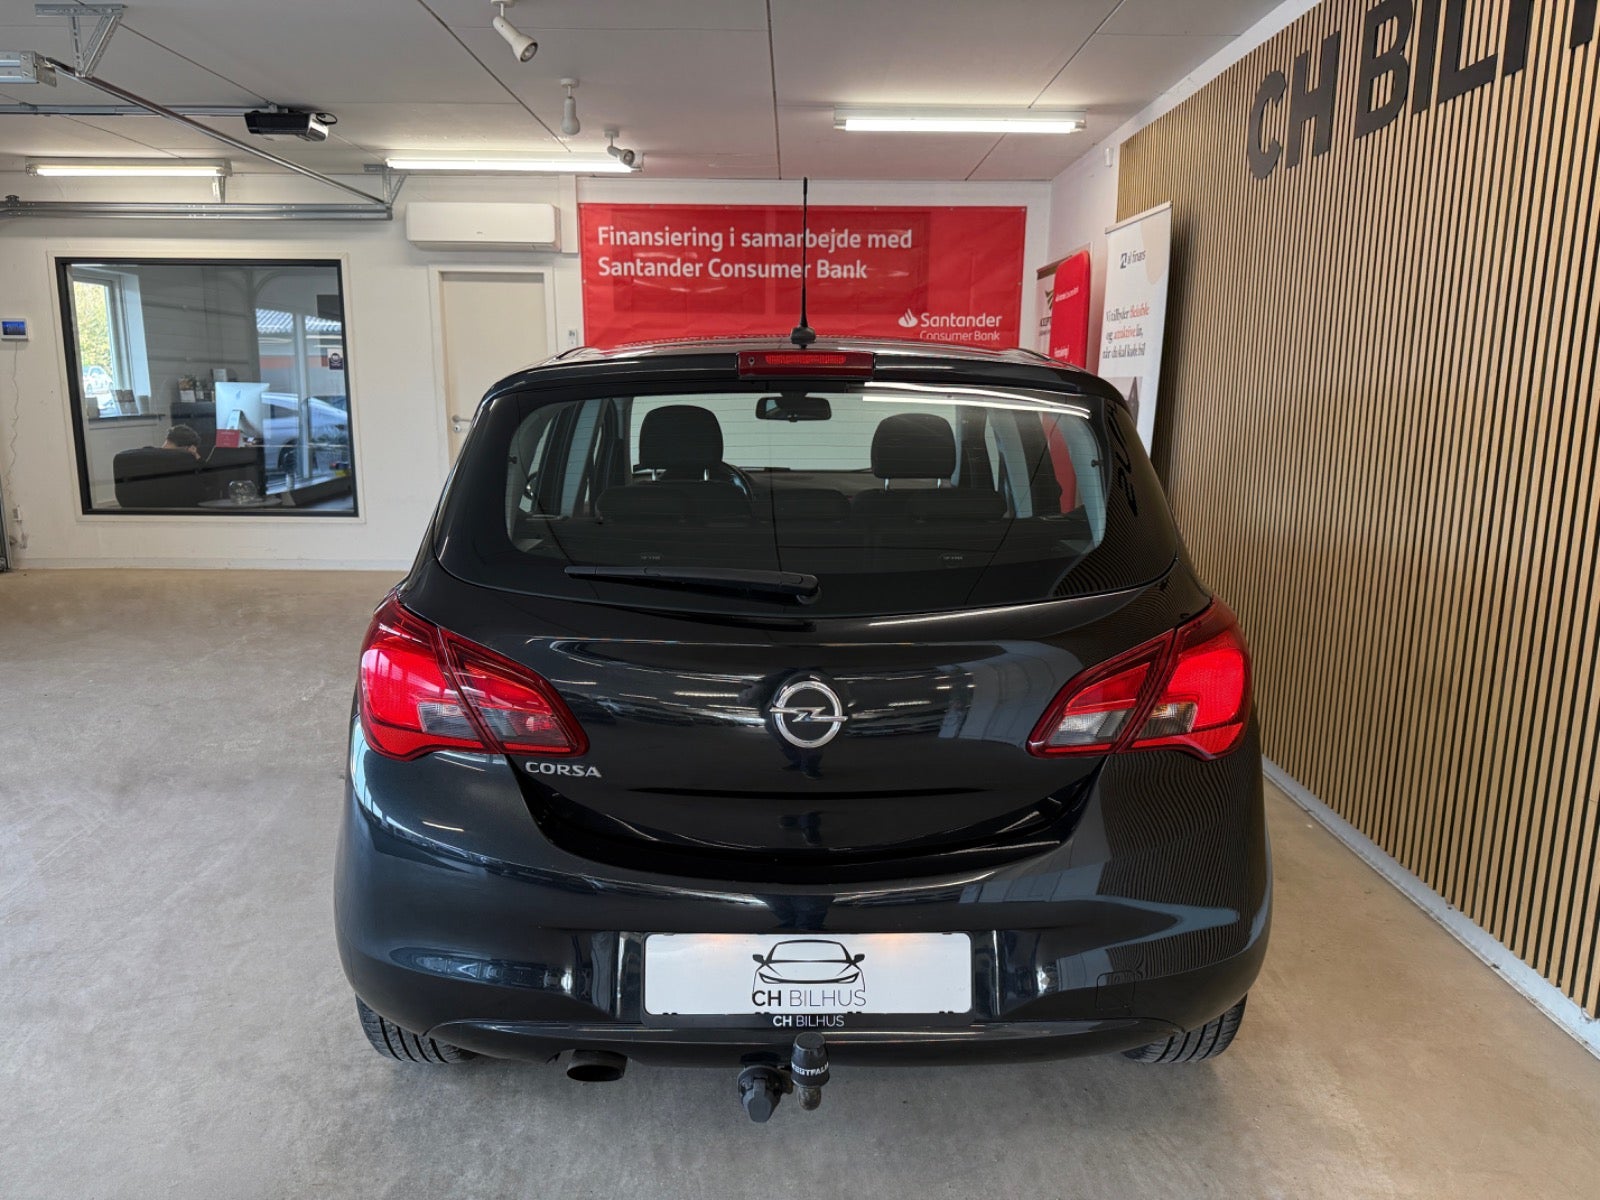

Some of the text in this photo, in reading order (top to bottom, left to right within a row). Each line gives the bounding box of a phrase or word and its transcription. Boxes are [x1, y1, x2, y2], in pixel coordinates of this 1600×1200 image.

[1247, 30, 1341, 180] CH
[598, 225, 912, 254] Finansiering i samarbejde med
[598, 257, 867, 278] Santander Consumer Bank
[920, 312, 1002, 328] Santander
[920, 330, 1001, 341] Consumer Bank
[525, 761, 602, 778] CORSA
[752, 989, 867, 1007] CH BILHUS
[772, 1015, 845, 1028] CH BILHUS
